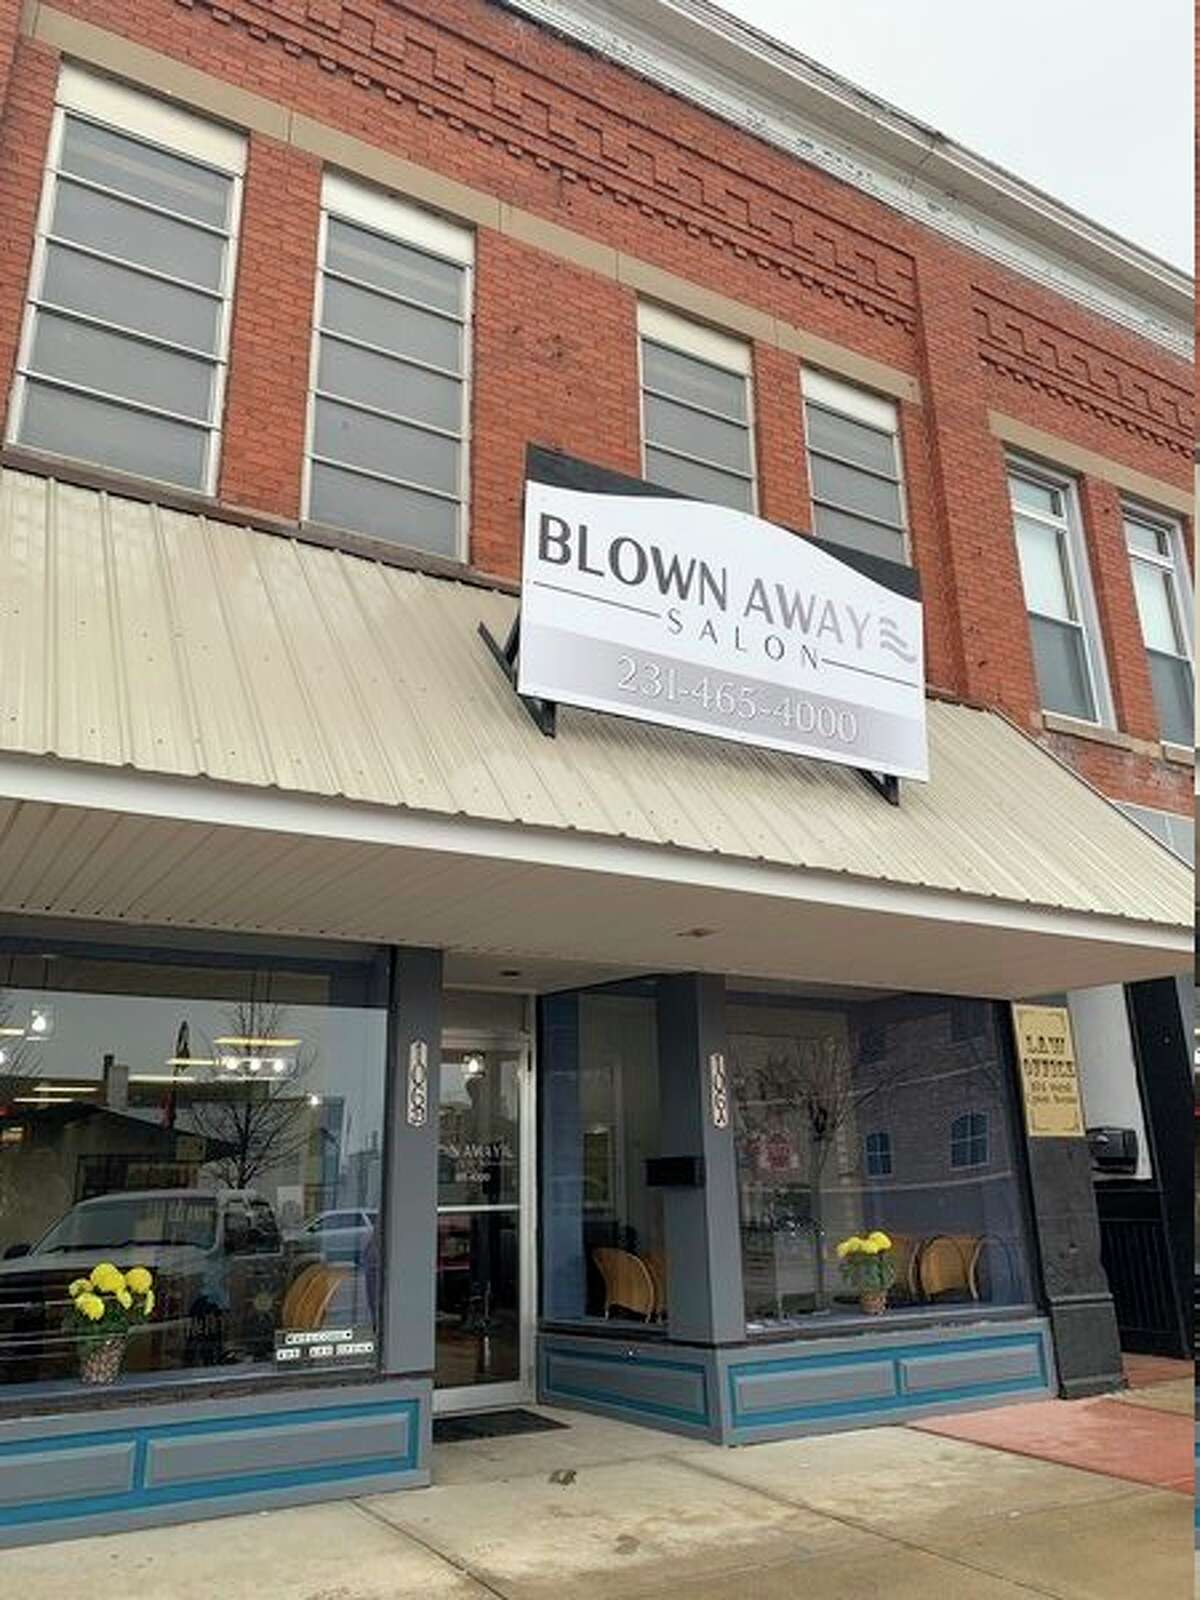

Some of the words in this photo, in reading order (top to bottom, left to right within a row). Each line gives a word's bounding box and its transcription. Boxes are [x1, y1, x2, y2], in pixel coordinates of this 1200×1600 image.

[537, 511, 728, 612] BLOWN
[743, 577, 871, 650] AWAY
[668, 607, 820, 670] SALON
[616, 655, 859, 743] 231-465-4000
[1023, 1057, 1076, 1078] OFFICE
[1025, 1035, 1066, 1054] LAW
